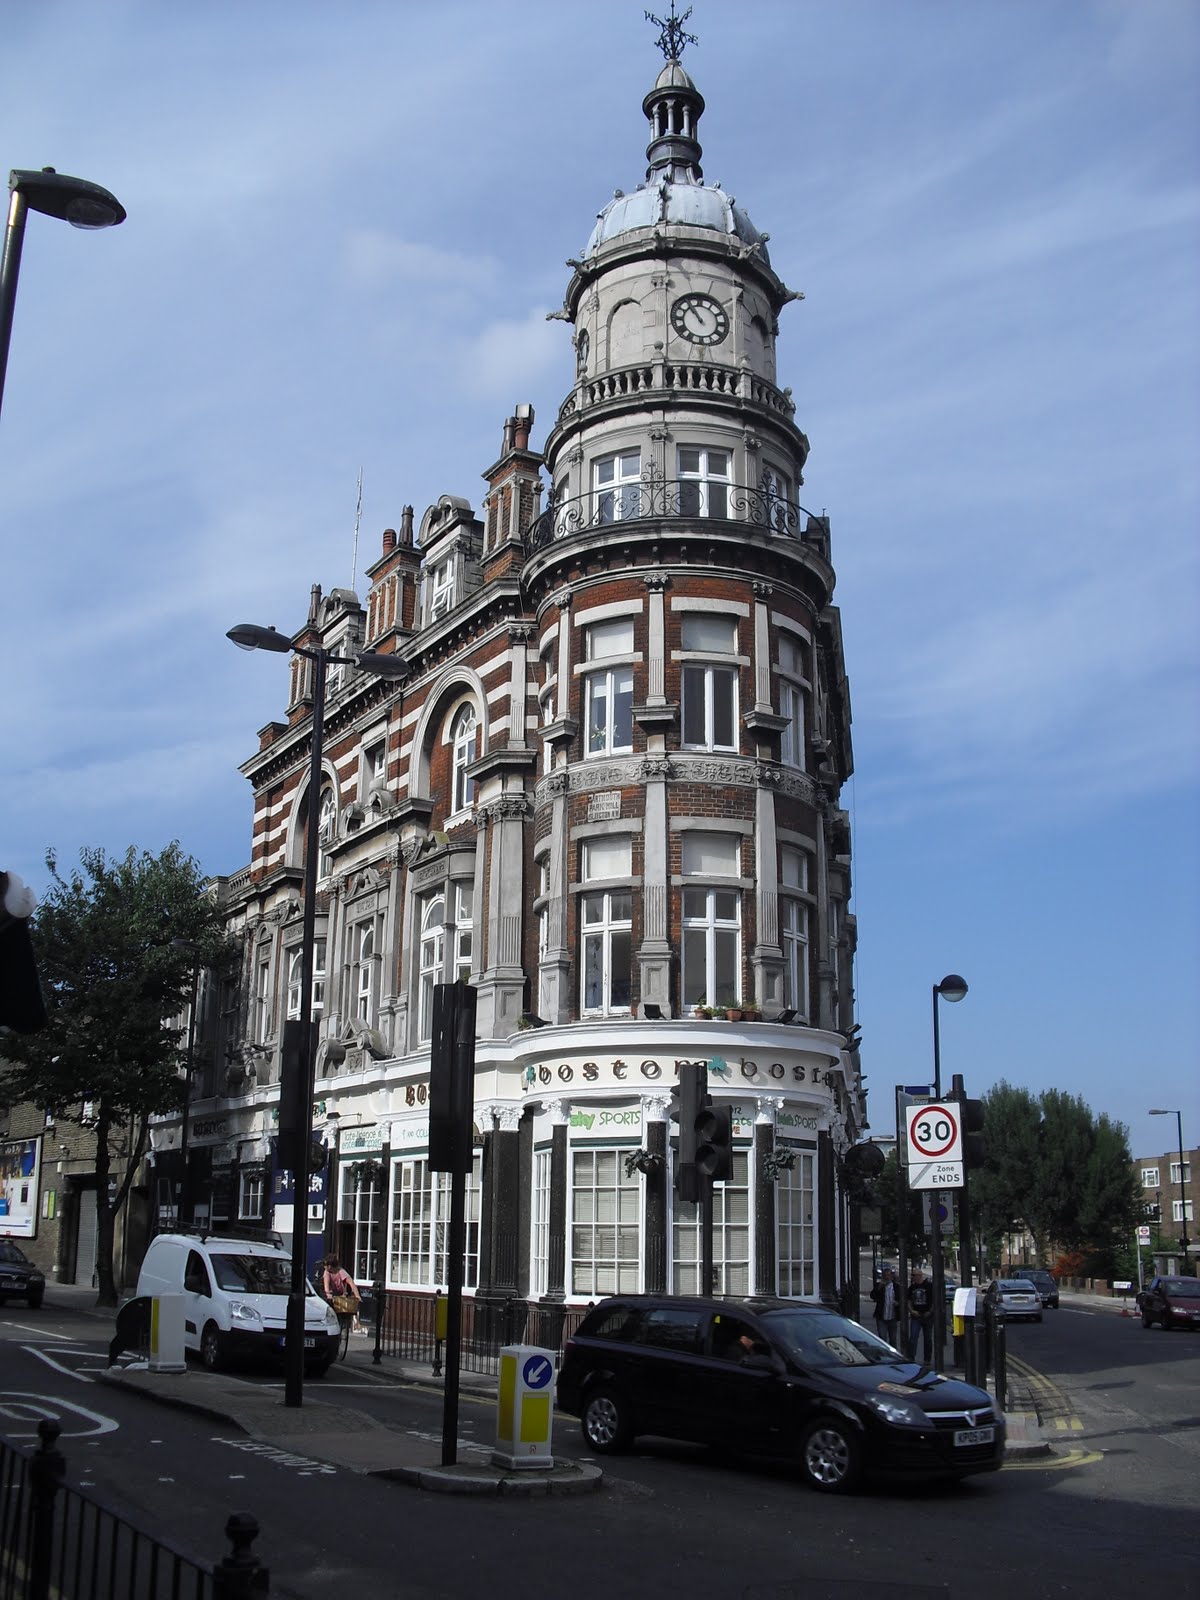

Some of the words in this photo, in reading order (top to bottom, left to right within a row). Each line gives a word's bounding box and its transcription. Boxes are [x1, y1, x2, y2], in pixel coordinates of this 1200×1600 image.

[590, 803, 605, 811] PARK
[569, 1111, 595, 1130] sky
[599, 1111, 641, 1126] SPORTS
[794, 1114, 817, 1131] SPORTS
[917, 1120, 951, 1142] 30
[932, 1174, 960, 1183] ENDS
